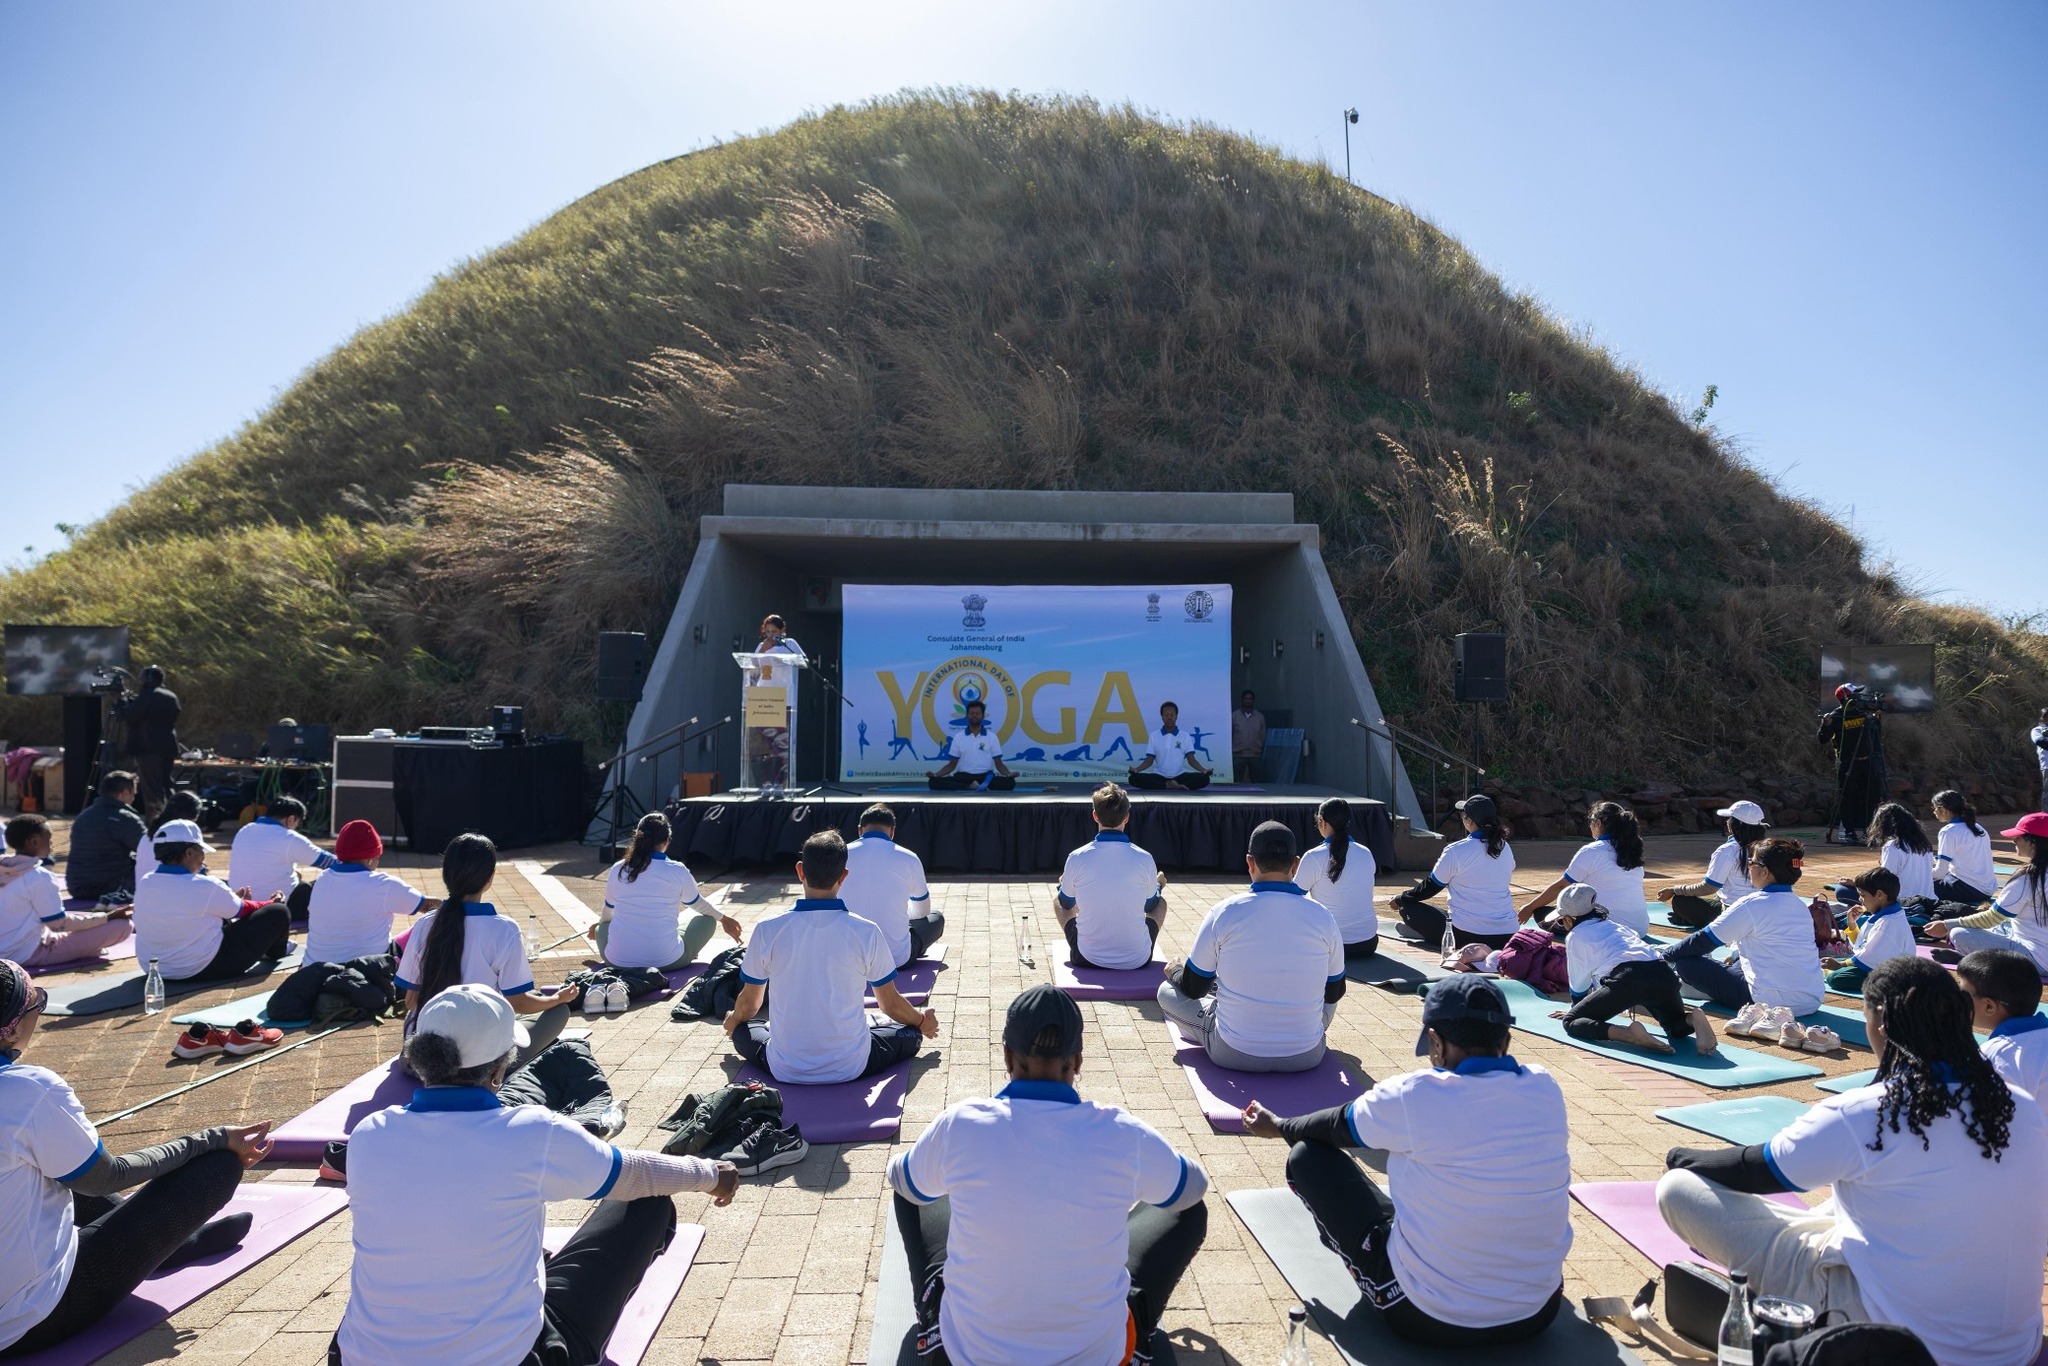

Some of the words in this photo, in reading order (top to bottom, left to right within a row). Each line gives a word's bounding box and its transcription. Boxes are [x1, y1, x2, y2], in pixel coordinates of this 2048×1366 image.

[949, 644, 1003, 652] Johannesburg
[924, 659, 988, 698] INTERNATIONAL
[990, 666, 1008, 683] DAY
[1005, 685, 1015, 698] OF
[876, 656, 1149, 747] YOGA
